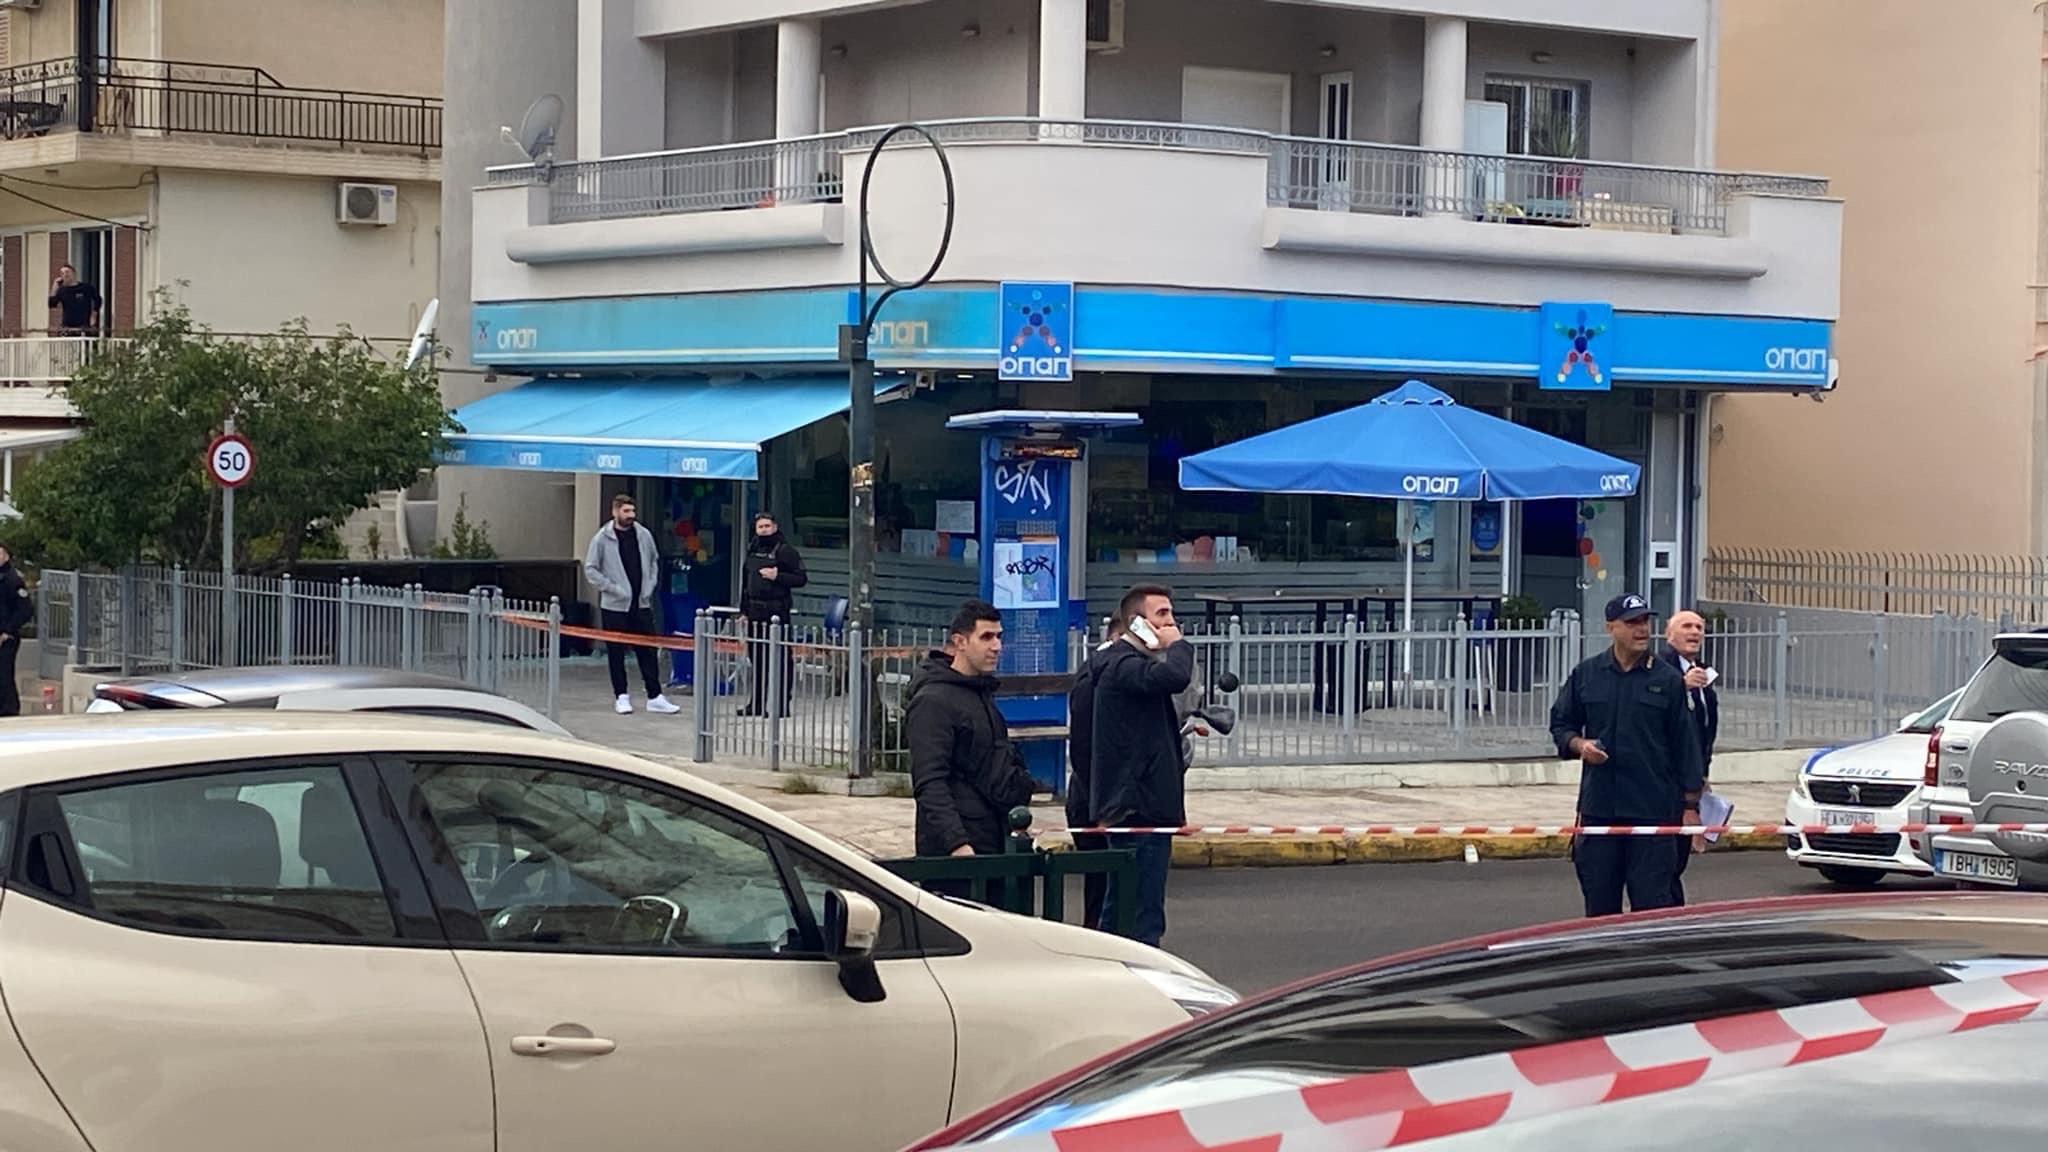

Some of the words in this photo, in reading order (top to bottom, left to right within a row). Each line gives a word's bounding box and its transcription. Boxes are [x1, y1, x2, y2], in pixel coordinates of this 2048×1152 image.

[219, 451, 246, 471] 50
[1837, 767, 1890, 777] POLICE
[1982, 857, 2015, 878] 1905
